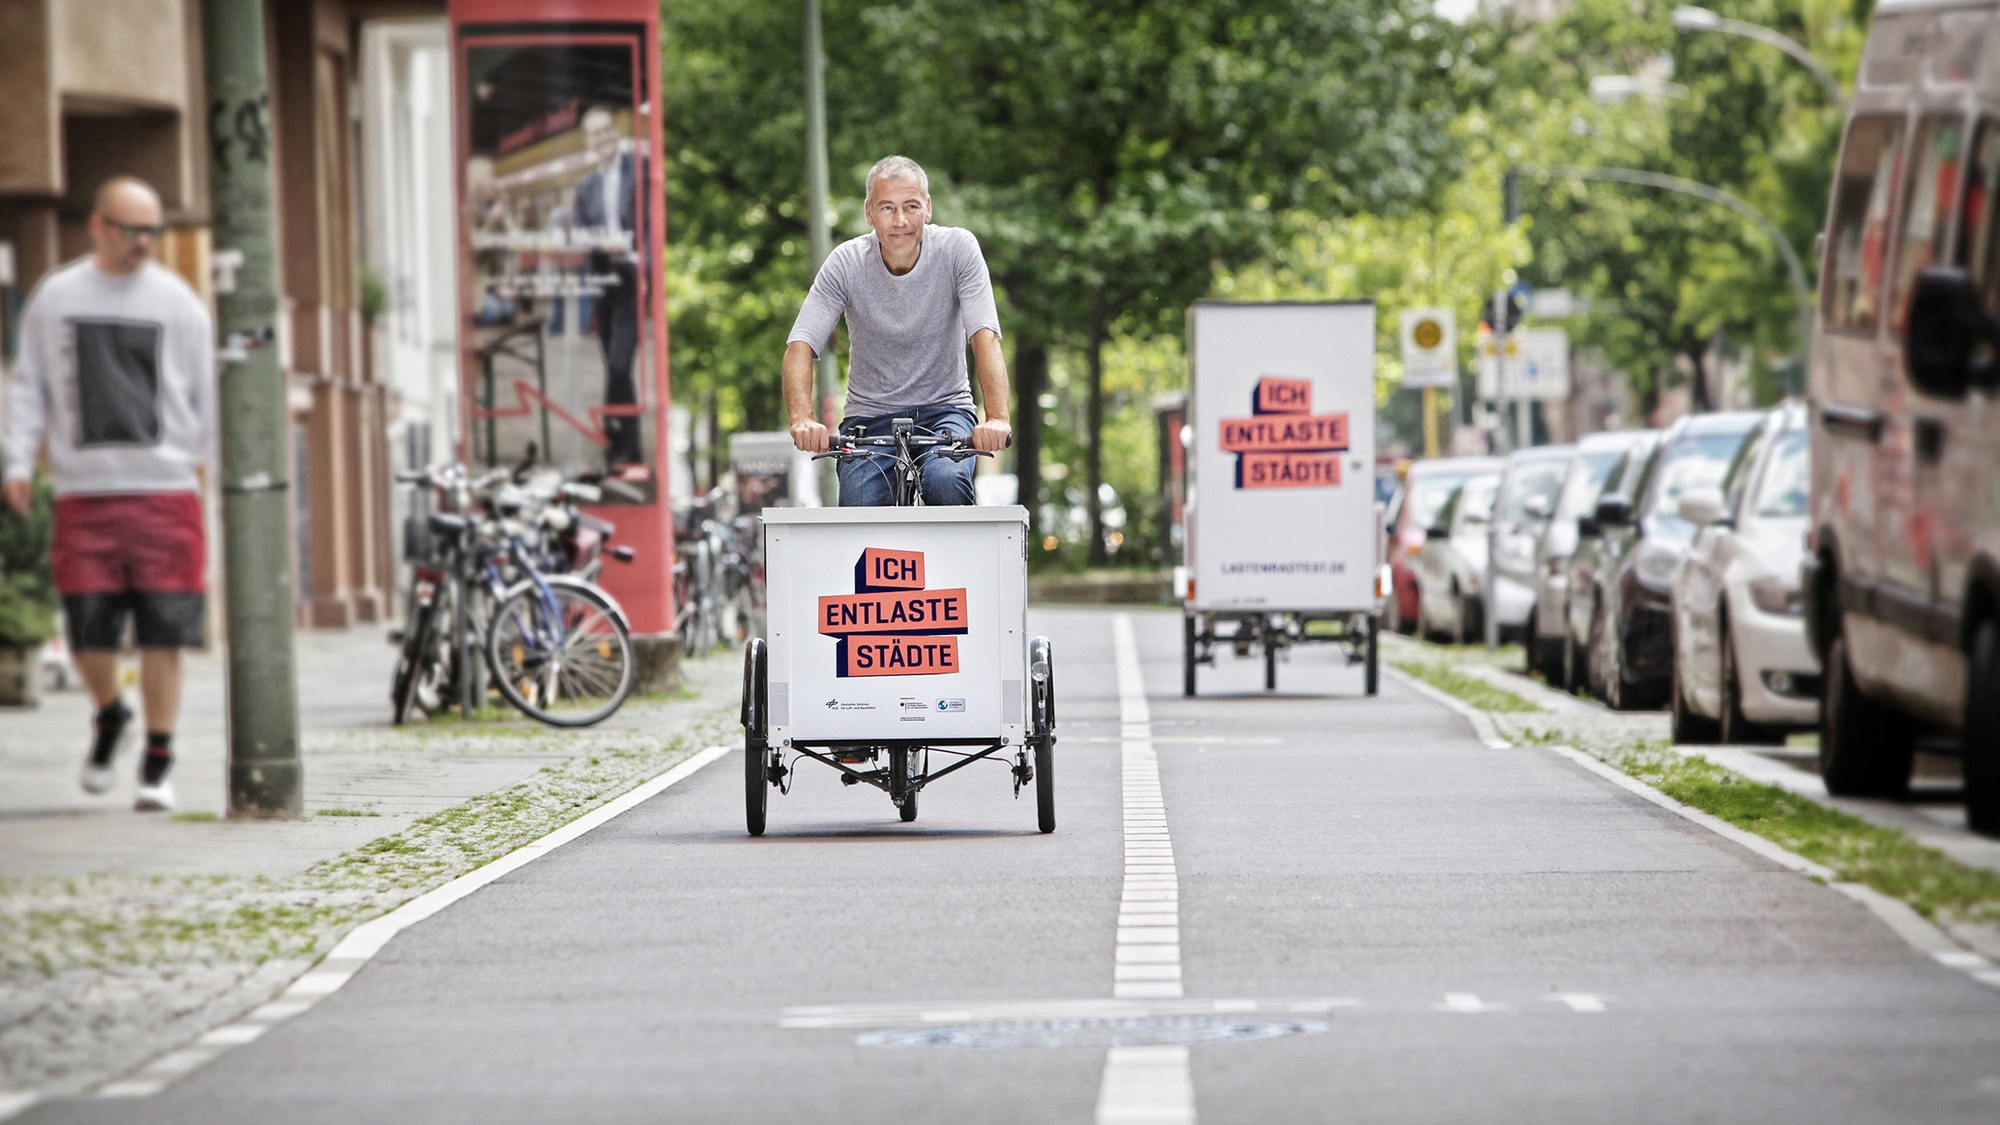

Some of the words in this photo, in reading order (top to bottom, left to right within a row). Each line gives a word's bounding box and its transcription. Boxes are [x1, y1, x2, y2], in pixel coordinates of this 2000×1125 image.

[1268, 383, 1306, 405] ICH
[1224, 420, 1342, 446] ENTLASTE
[1251, 455, 1334, 482] STÄDTE
[875, 557, 917, 581] ICH
[826, 597, 959, 626] ENTLASTE
[856, 638, 953, 669] STÄDTE
